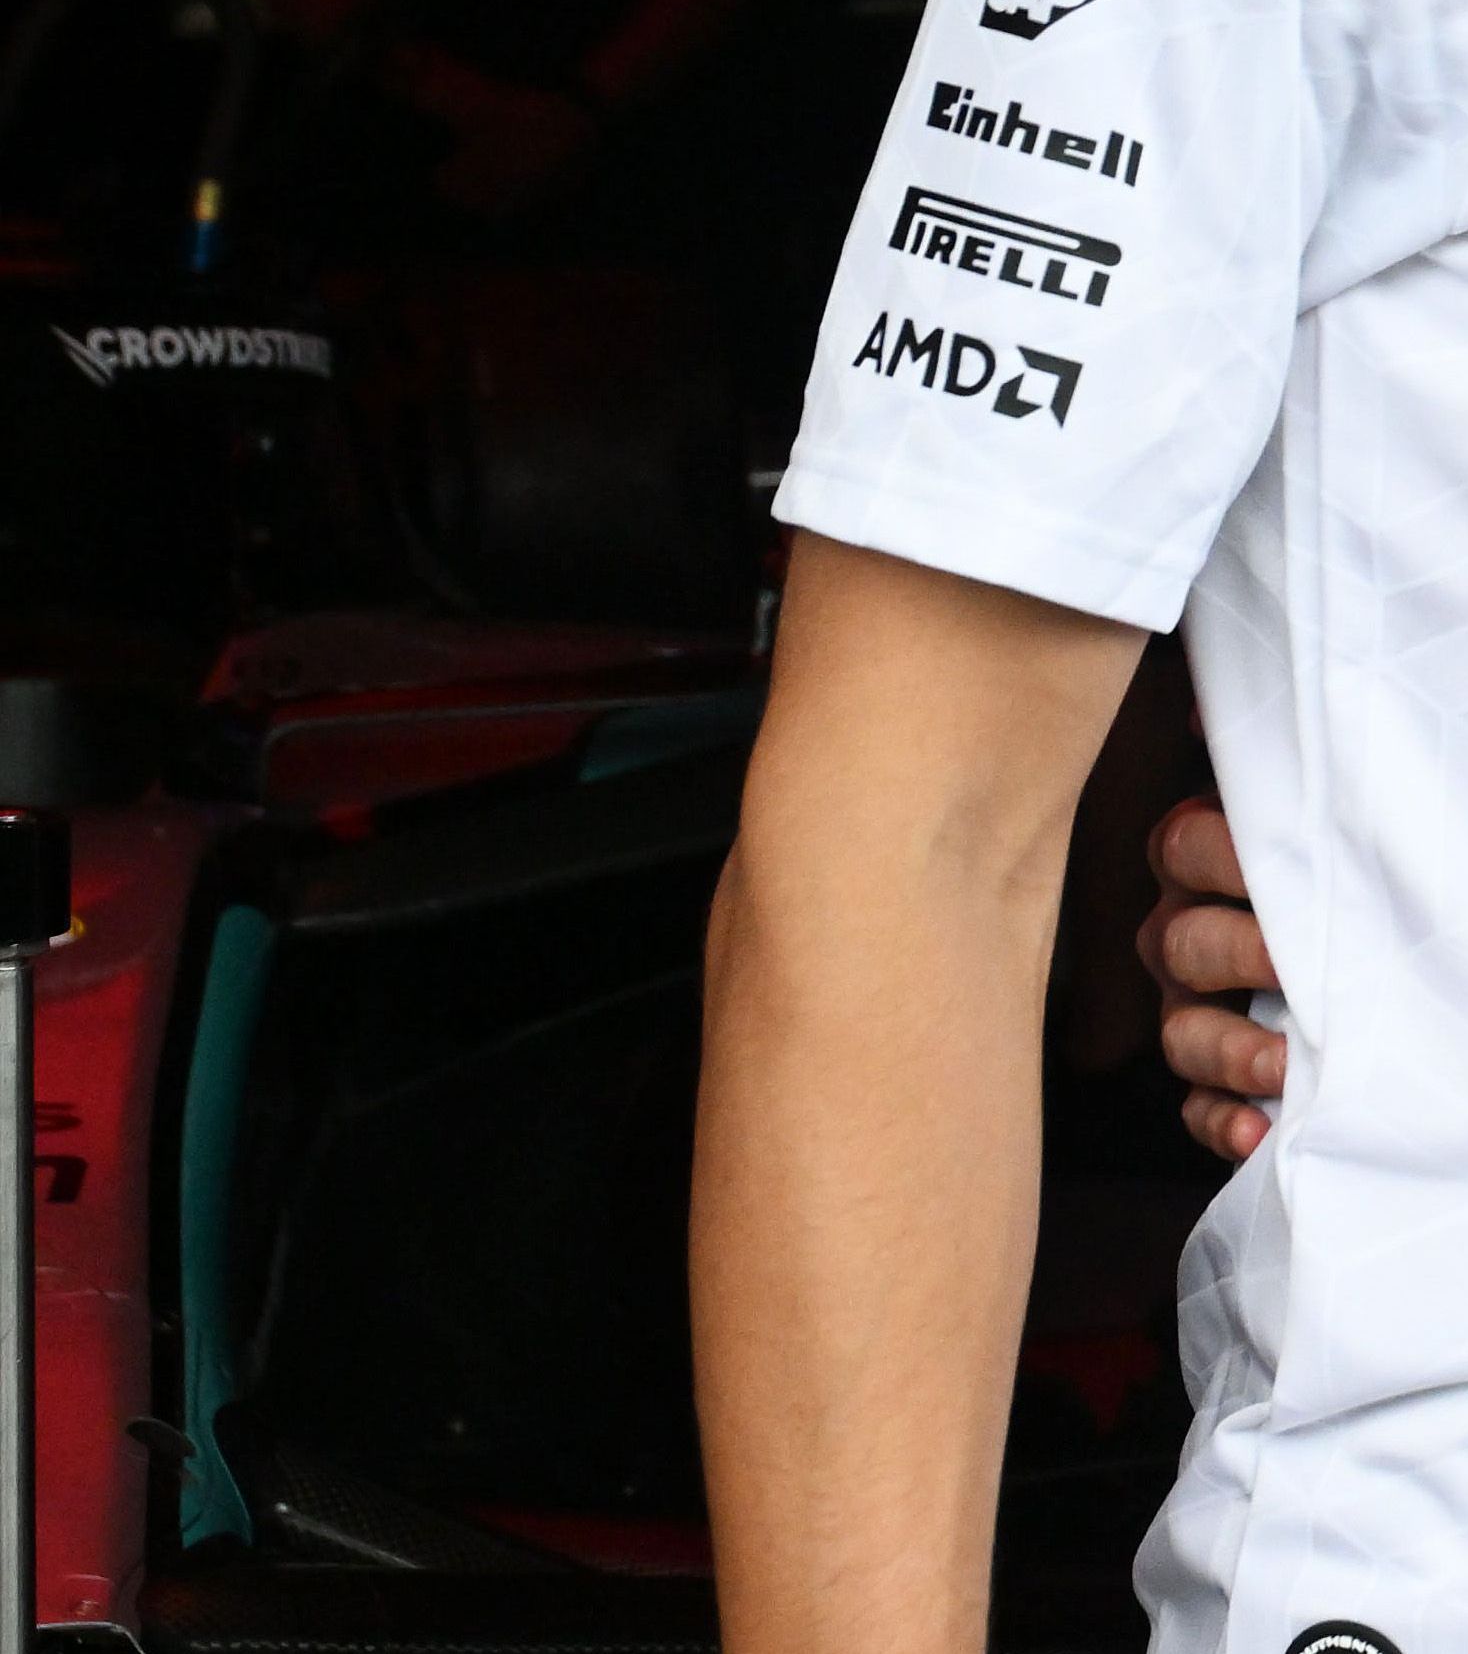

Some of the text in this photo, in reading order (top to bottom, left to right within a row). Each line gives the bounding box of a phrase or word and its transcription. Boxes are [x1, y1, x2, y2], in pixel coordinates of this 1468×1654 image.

[926, 80, 1144, 188] Einhell
[888, 185, 1122, 307] PIRELLI
[852, 310, 997, 398] AMD
